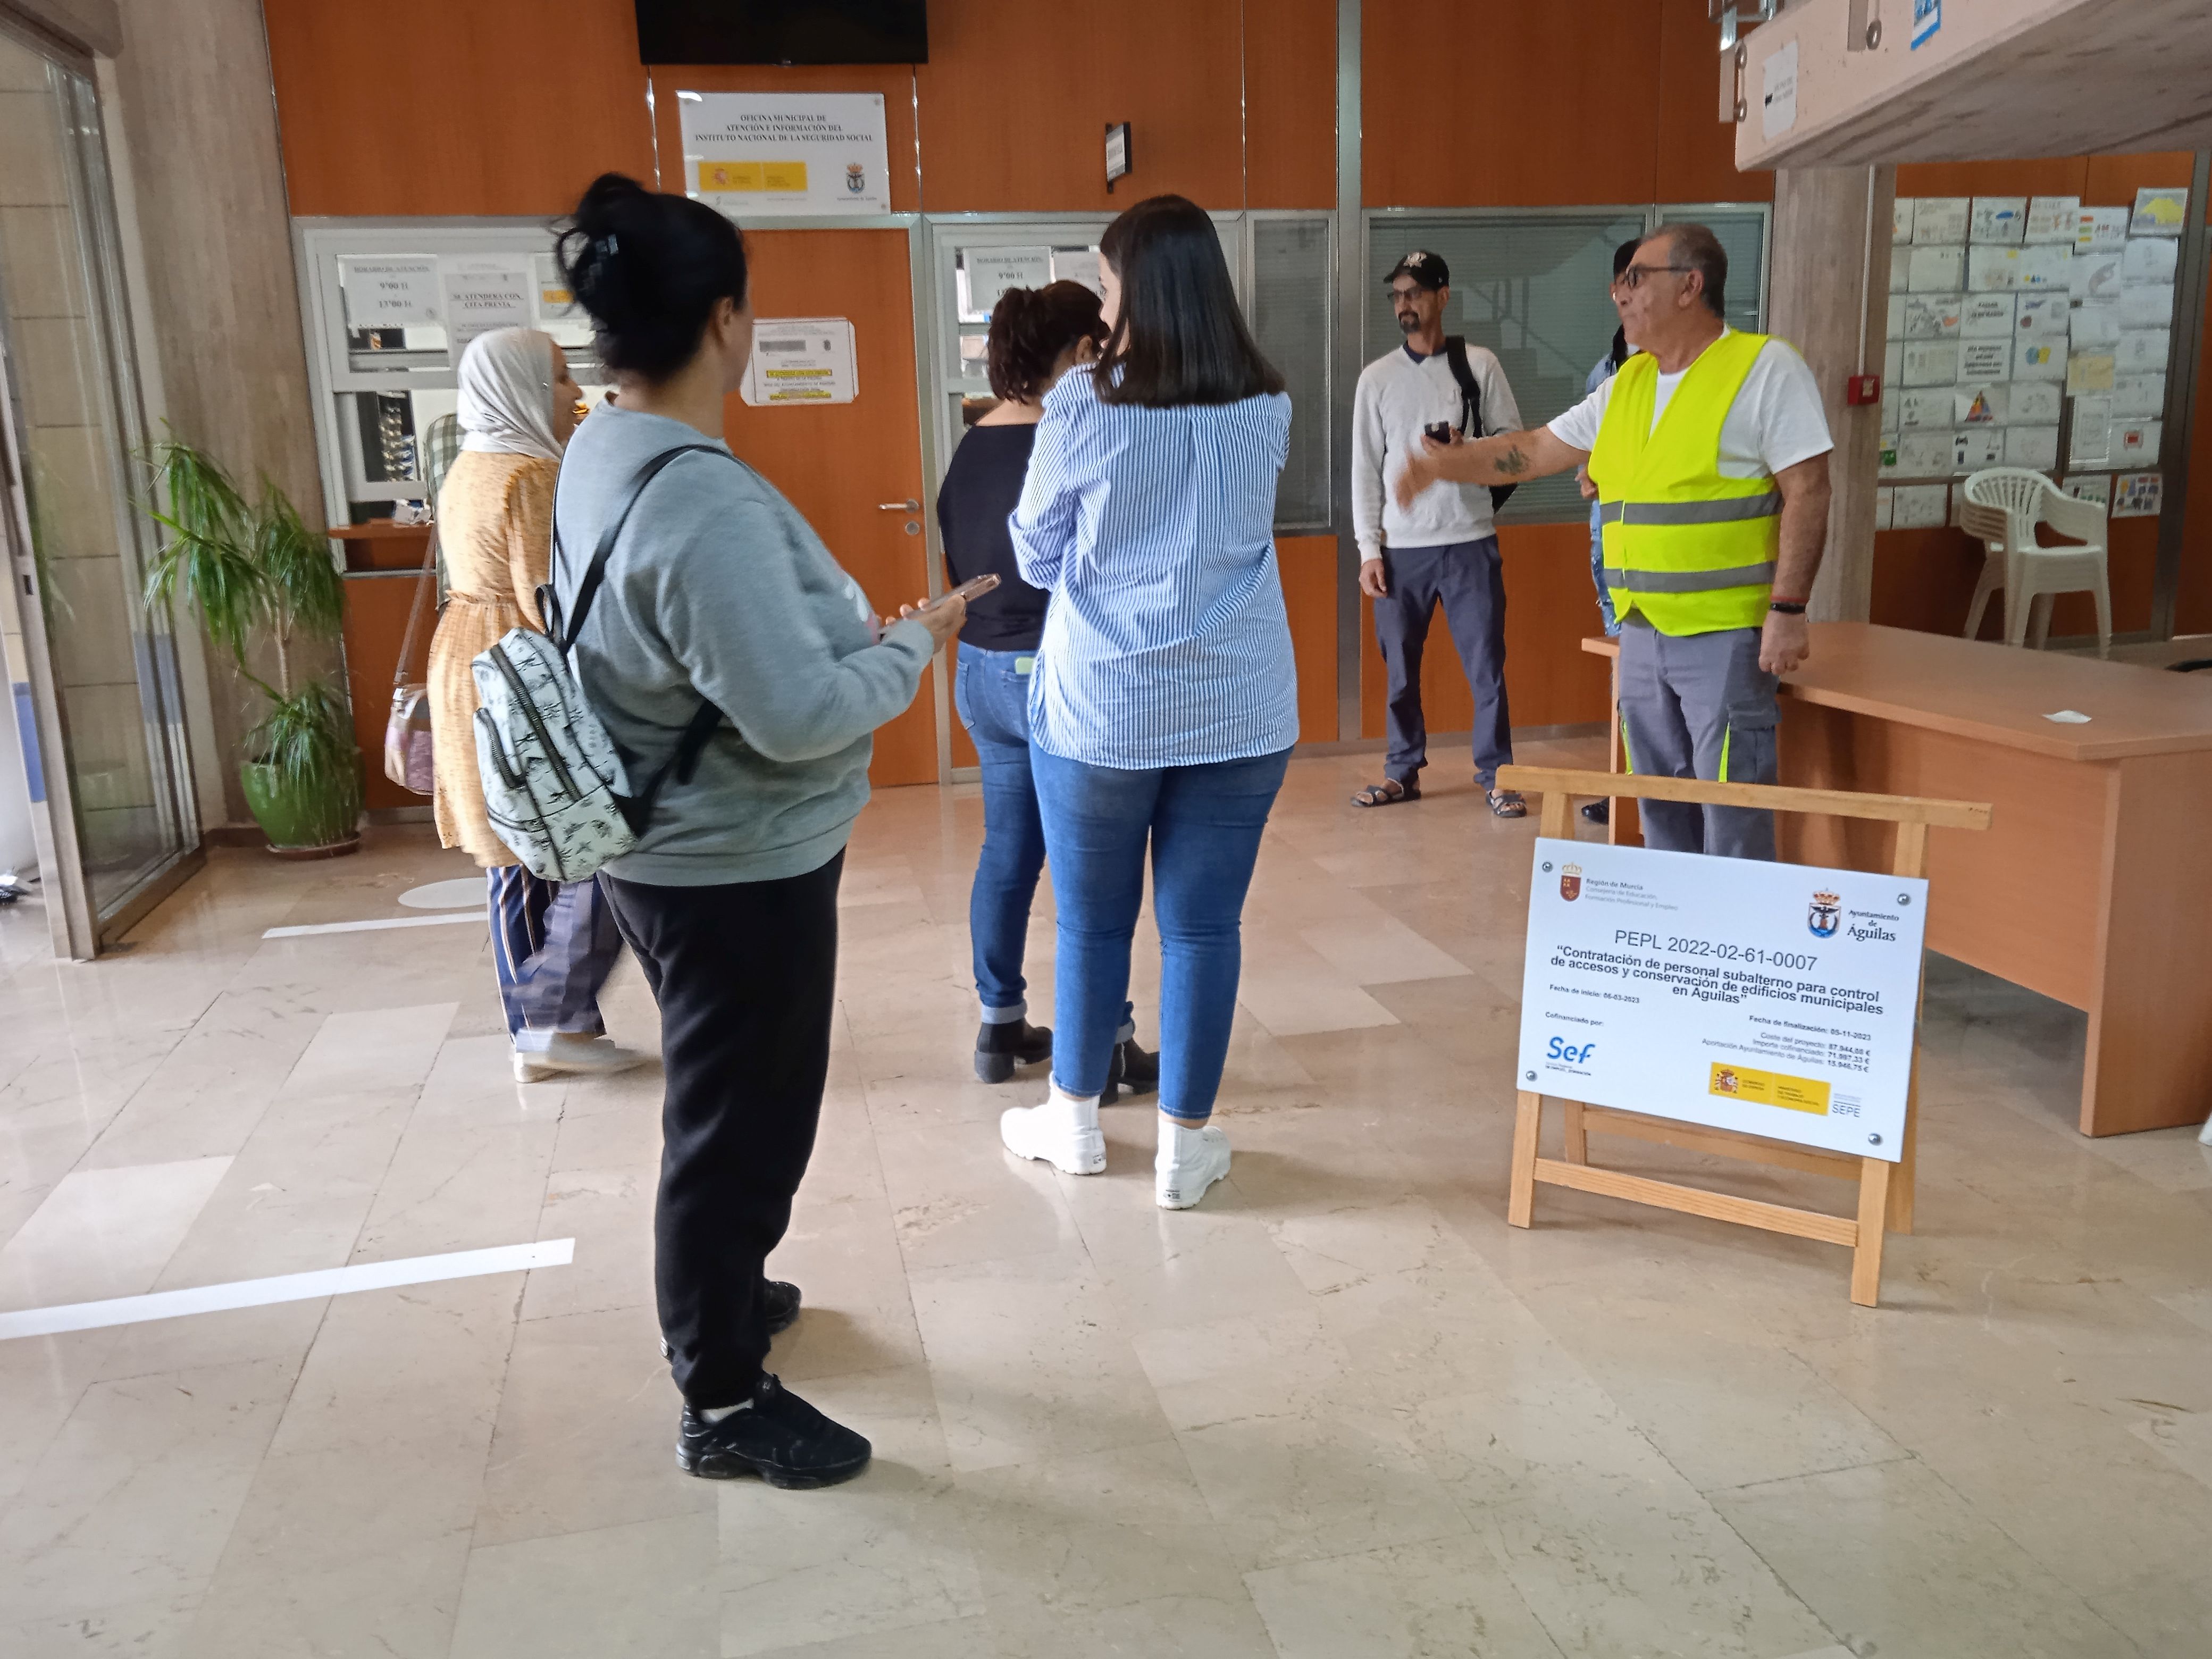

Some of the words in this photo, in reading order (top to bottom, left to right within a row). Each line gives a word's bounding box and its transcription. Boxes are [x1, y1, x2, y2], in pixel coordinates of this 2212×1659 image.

[1586, 878, 1609, 887] Región
[1620, 882, 1644, 891] Murcia
[1848, 909, 1900, 921] Ayuntamiento
[1847, 923, 1896, 942] Águilas
[1614, 929, 1662, 950] PEPL
[1668, 936, 1818, 971] 2022-02-61-0007
[1551, 956, 1565, 967] de
[1569, 960, 1619, 975] accesos
[1622, 967, 1630, 978] y
[1632, 969, 1718, 990] conservación
[1722, 980, 1738, 992] de
[1741, 984, 1797, 1002] edificios
[1800, 993, 1884, 1015] municipales
[1645, 958, 1660, 969] de
[1664, 962, 1720, 978] personal
[1723, 970, 1793, 989] subalterno
[1796, 982, 1826, 994] para
[1830, 987, 1880, 1002] control
[1603, 993, 1640, 1003] 06-03-2023
[1672, 986, 1688, 996] en
[1545, 1011, 1589, 1024] Cofinanciado
[1749, 1015, 1771, 1025] Fecha
[1783, 1021, 1828, 1033] finalización:
[1830, 1028, 1871, 1041] 05-11-2023
[1547, 1036, 1596, 1064] Sef
[1832, 1104, 1861, 1118] SEPE
